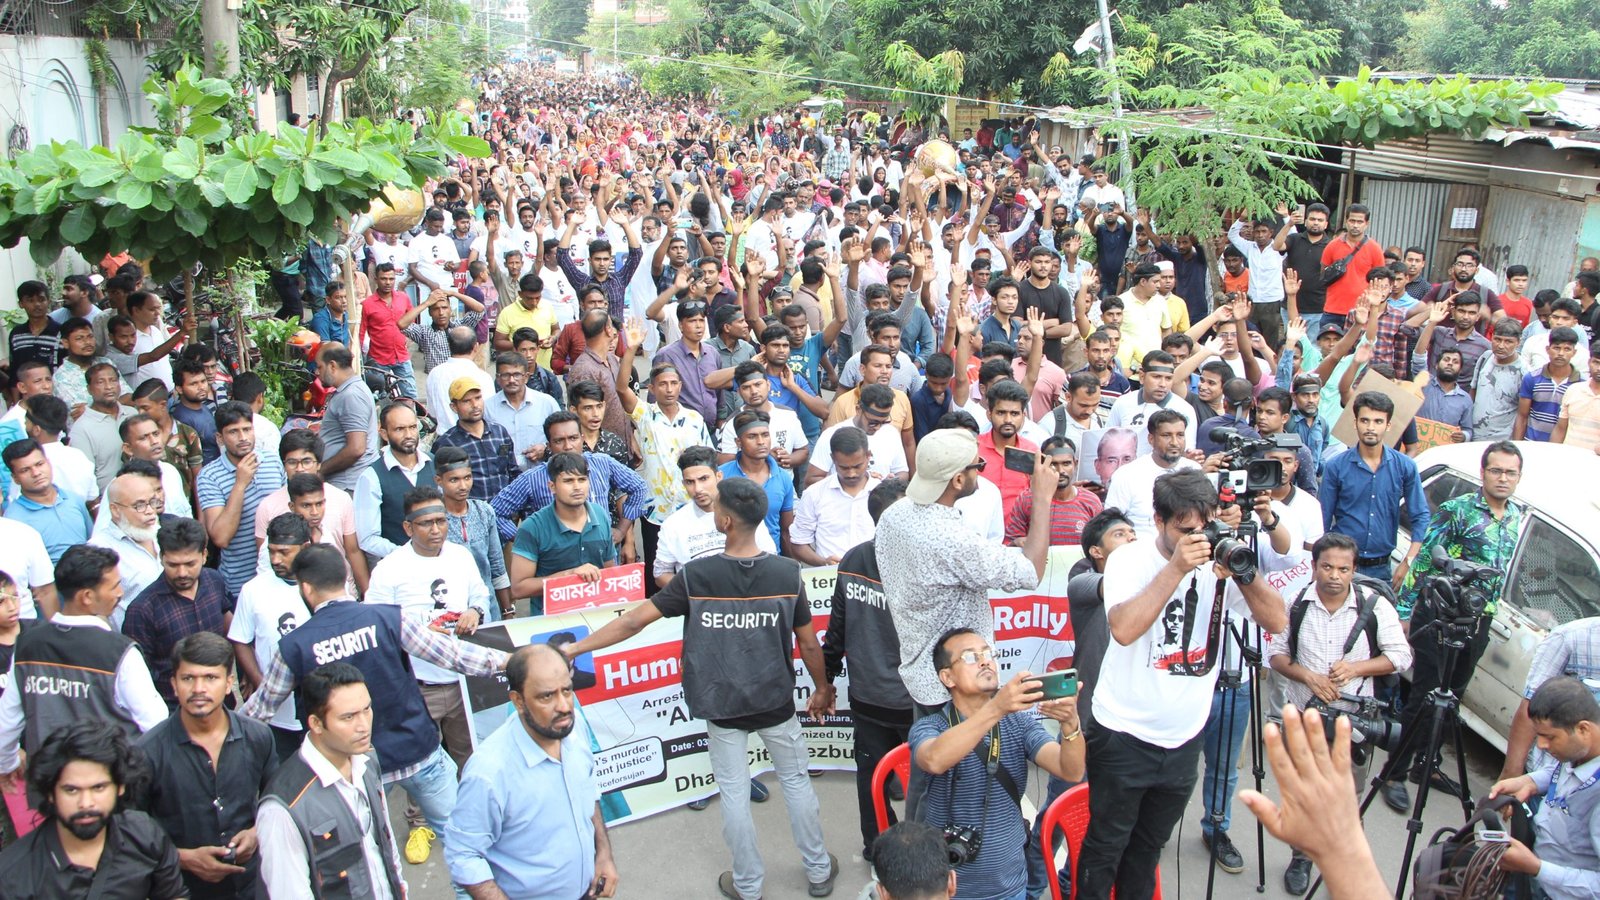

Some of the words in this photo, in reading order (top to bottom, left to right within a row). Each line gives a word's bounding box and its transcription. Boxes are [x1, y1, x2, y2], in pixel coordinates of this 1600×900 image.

[550, 582, 601, 602] আমরা
[604, 569, 642, 592] সবাই
[812, 576, 836, 589] ter
[701, 611, 780, 629] SECURITY
[992, 603, 1068, 636] Rally
[312, 624, 379, 666] SECURITY
[998, 647, 1022, 660] ible
[603, 657, 682, 690] Hum
[25, 675, 90, 699] SECURITY
[642, 690, 685, 710] Arrest
[656, 706, 693, 726] "A
[823, 715, 853, 723] Uttara,
[801, 731, 834, 739] nized
[837, 731, 852, 741] by
[610, 744, 650, 761] murder
[670, 742, 695, 753] Date:
[596, 767, 614, 777] ant
[674, 773, 717, 793] Dha
[807, 745, 856, 760] ezbu
[597, 770, 645, 789] iceforsujan
